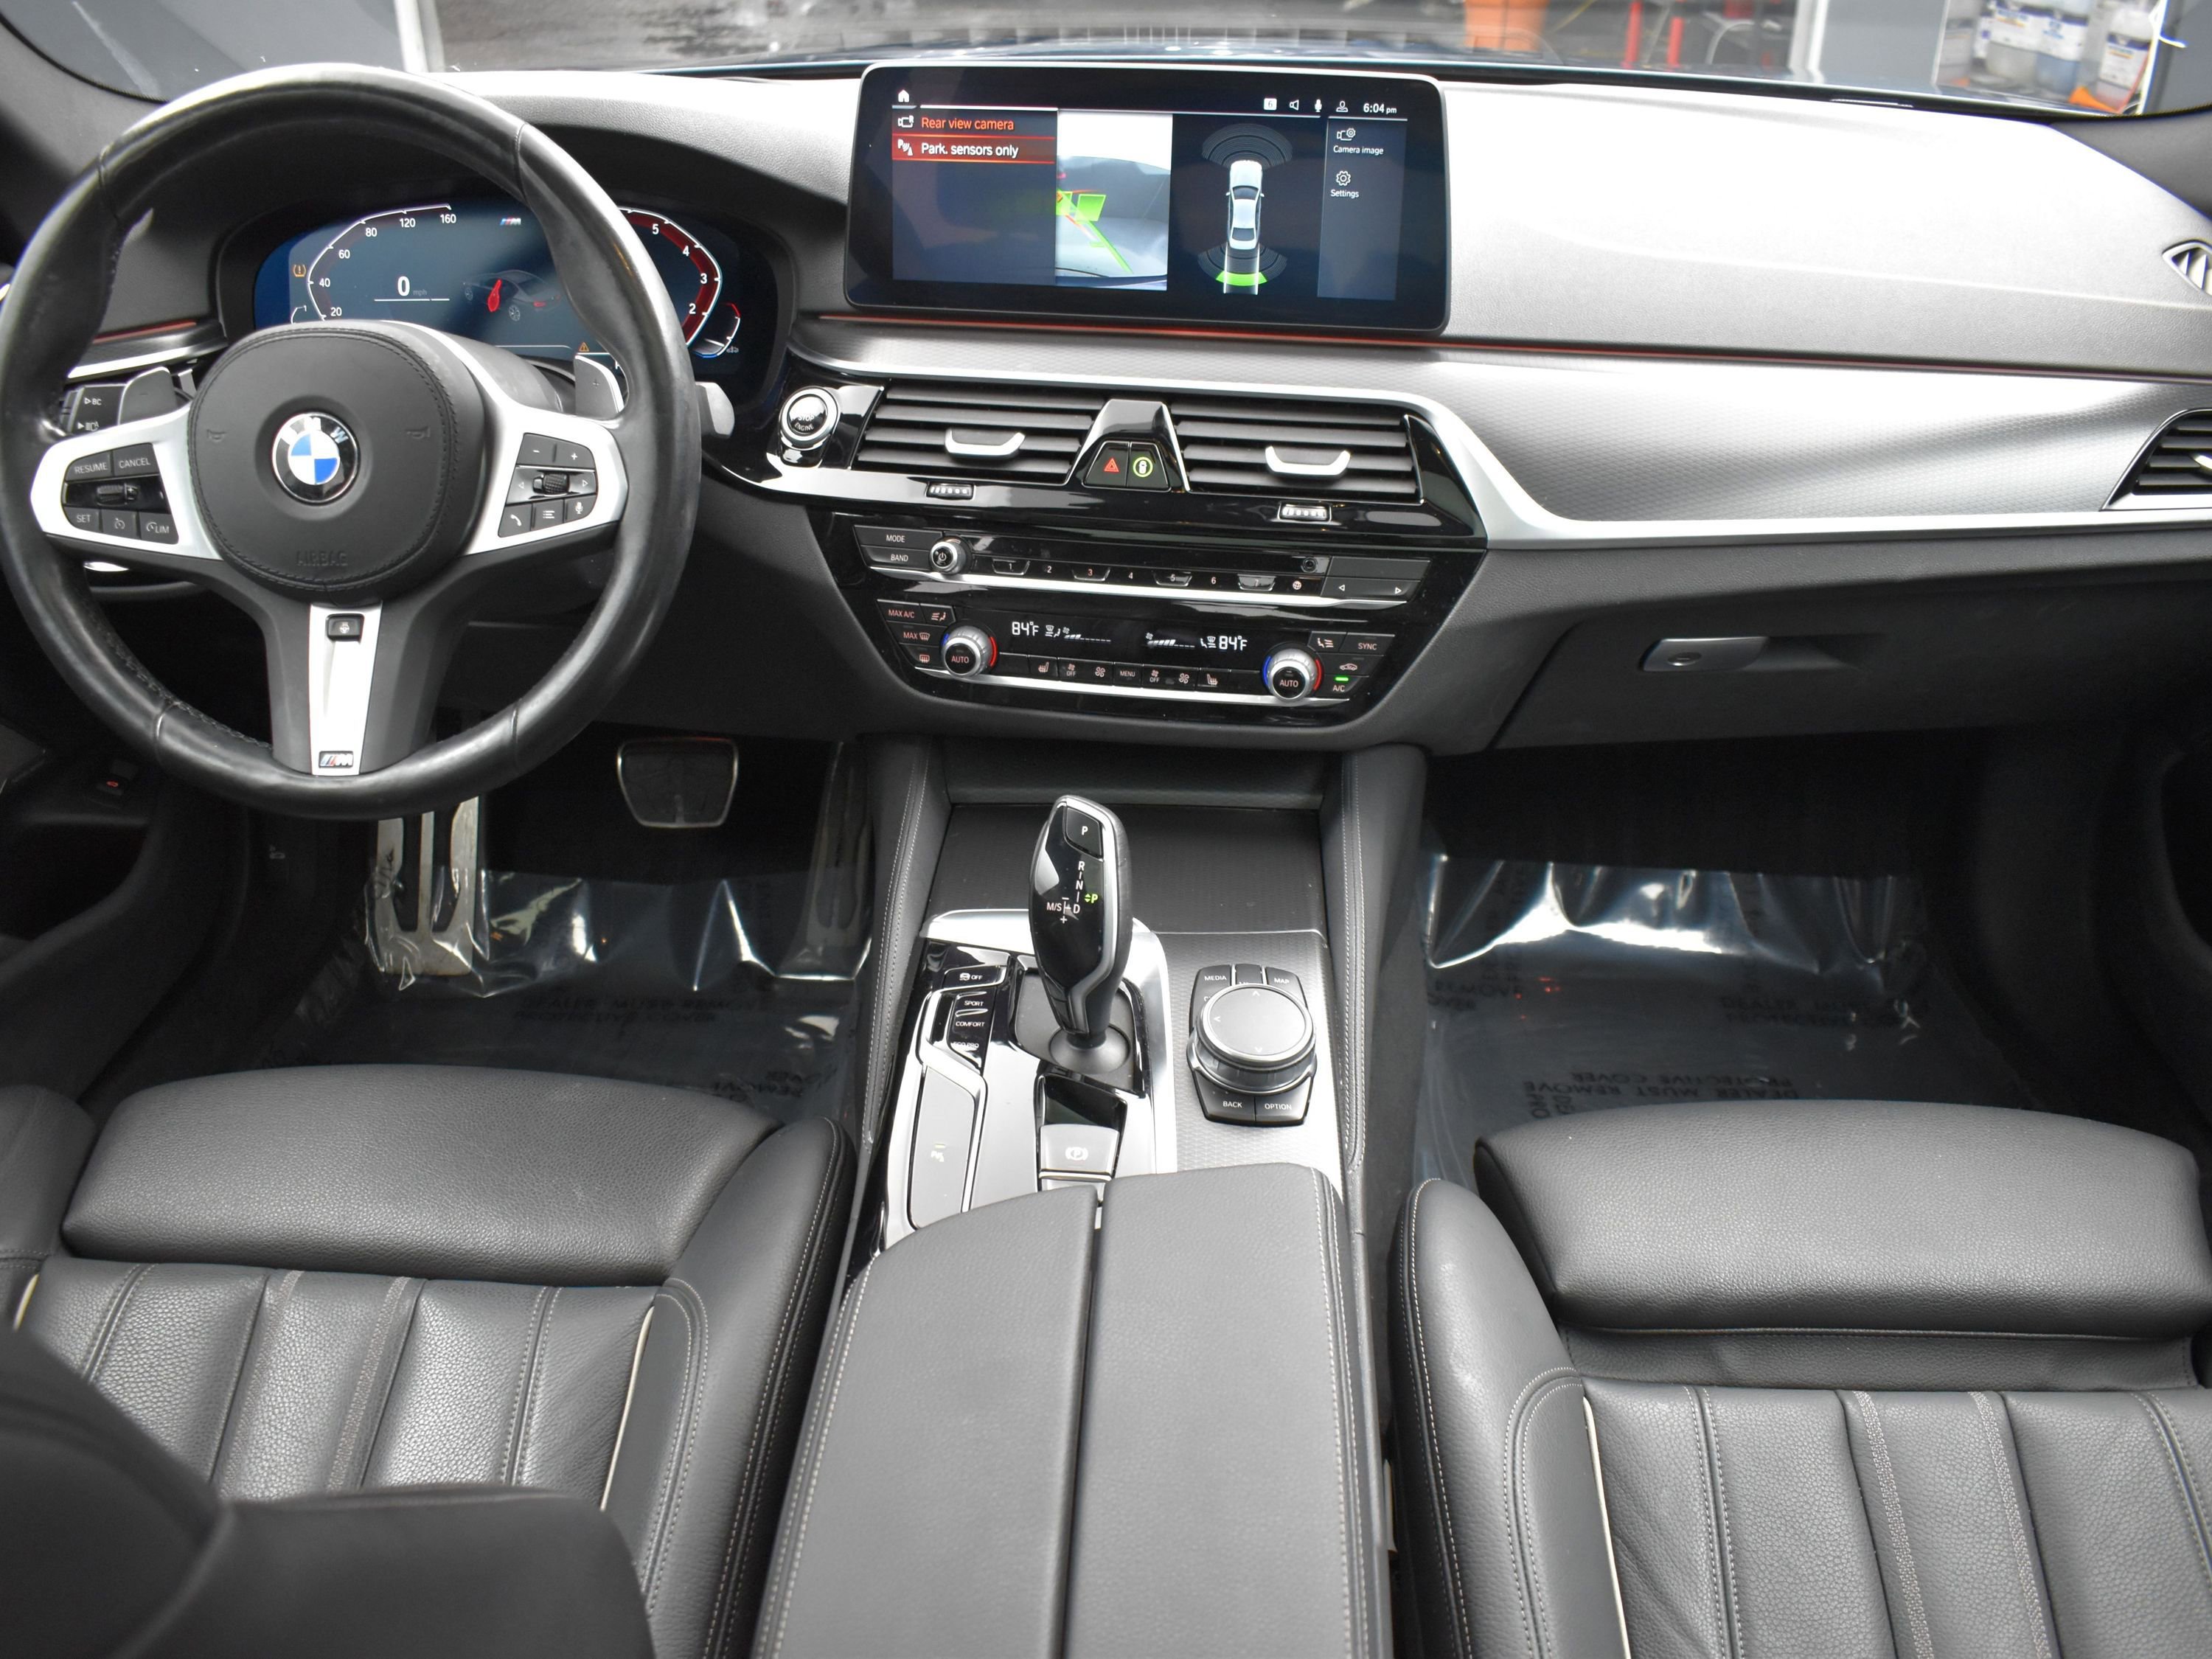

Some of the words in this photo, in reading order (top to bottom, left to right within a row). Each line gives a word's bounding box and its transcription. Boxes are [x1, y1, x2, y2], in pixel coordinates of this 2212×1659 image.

[1363, 103, 1385, 114] 6:04
[1386, 107, 1397, 115] pm
[922, 117, 946, 128] Rear
[948, 118, 971, 129] view
[975, 120, 1014, 131] camera
[922, 143, 948, 155] Park.
[950, 145, 993, 156] sensors
[995, 145, 1019, 159] only
[1333, 145, 1360, 154] Camera
[1362, 147, 1384, 156] image
[1331, 189, 1359, 198] Settings
[400, 218, 416, 228] 120
[440, 214, 456, 223] 160
[365, 228, 378, 237] 80
[652, 224, 659, 234] 5
[338, 249, 350, 260] 60
[683, 246, 689, 256] 4
[319, 278, 330, 288] 40
[700, 273, 708, 284] 3
[397, 276, 410, 296] 0
[330, 307, 342, 316] 20
[689, 303, 696, 314] 2
[795, 422, 815, 431] ENGINE
[74, 462, 108, 474] RESUME
[119, 458, 150, 469] CANCEL
[77, 515, 91, 523] SET
[886, 534, 905, 543] MODE
[296, 550, 348, 566] AIRBAG
[891, 554, 908, 562] BAND
[1047, 566, 1052, 574] 2
[1088, 568, 1093, 577] 3
[1170, 574, 1175, 582] 5
[1211, 577, 1217, 585] 6
[888, 610, 902, 618] MAX
[1357, 642, 1377, 650] SYNC
[951, 655, 969, 664] AUTO
[1279, 679, 1298, 688] AUTO
[1332, 684, 1346, 692] A/C
[1081, 826, 1088, 835] P
[1078, 860, 1085, 871] R
[1076, 880, 1083, 890] N
[1091, 894, 1098, 903] P
[1047, 902, 1062, 911] M/S
[1073, 904, 1080, 914] D
